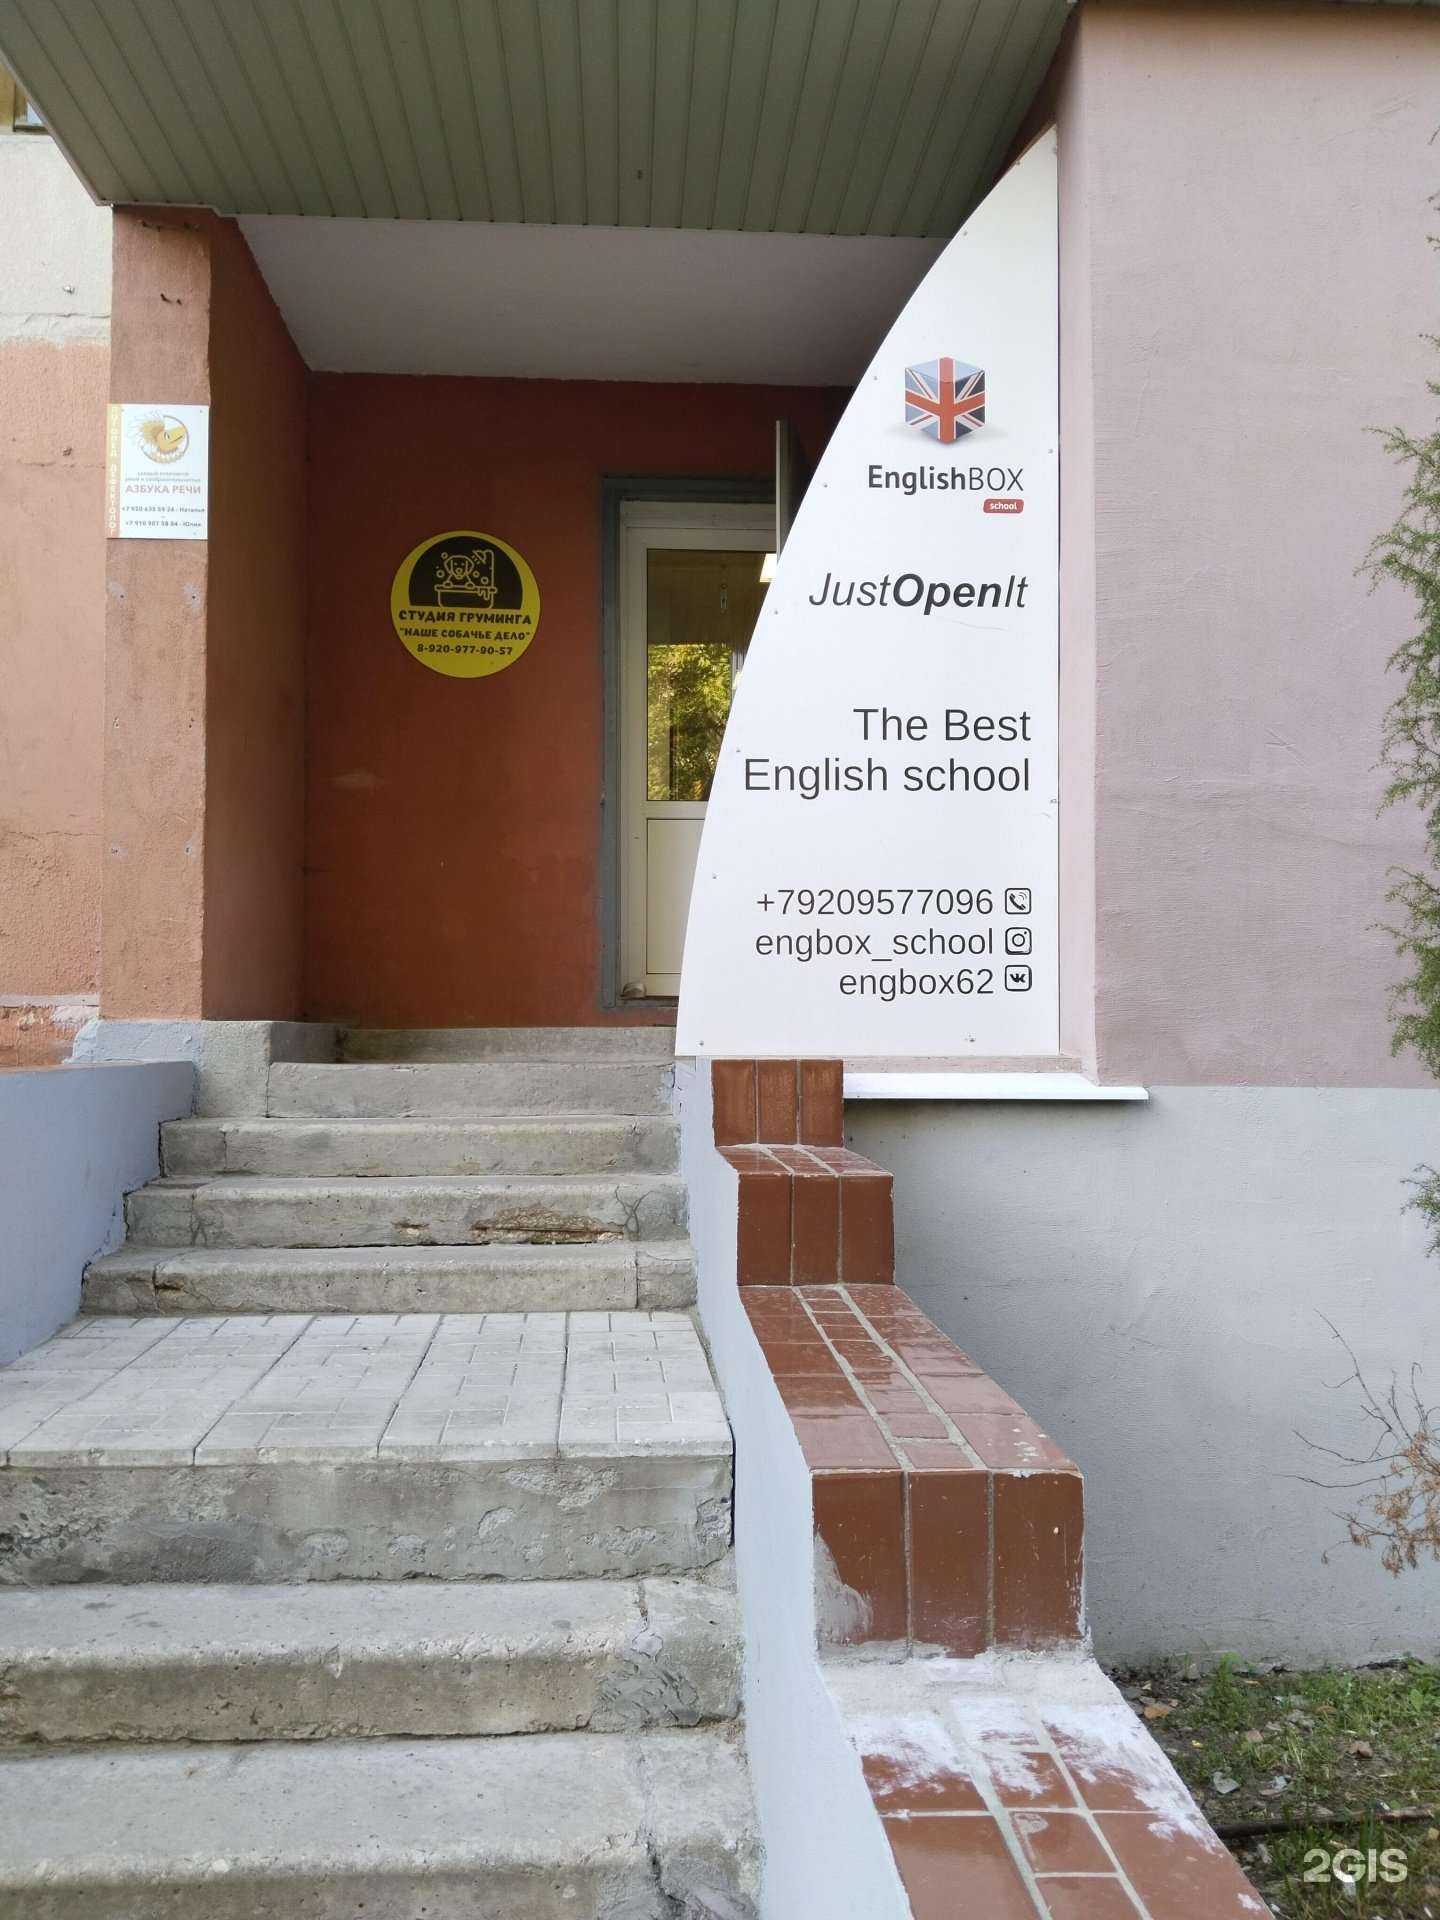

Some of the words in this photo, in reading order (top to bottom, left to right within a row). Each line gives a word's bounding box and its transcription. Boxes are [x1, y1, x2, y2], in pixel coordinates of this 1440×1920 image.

[125, 484, 170, 494] АЗБУКА
[172, 484, 201, 494] РЕЧИ
[868, 464, 1024, 495] EnglishBOX
[989, 502, 1018, 510] school
[809, 572, 1029, 615] JustOpenIt
[399, 610, 456, 623] СТУДИЯ
[459, 612, 532, 625] ГРУМИНГА
[400, 627, 440, 637] "НАШЕ
[441, 629, 492, 639] СОБАЧЬЕ
[494, 631, 531, 642] ДЕЛО"
[416, 643, 513, 656] 8-920-977-90-57
[853, 707, 928, 741] The
[945, 708, 1032, 741] Best
[745, 757, 888, 800] English
[903, 758, 1030, 791] school
[756, 889, 994, 915] +79209577096
[755, 928, 993, 962] engbox_school
[839, 968, 994, 1002] engbox62
